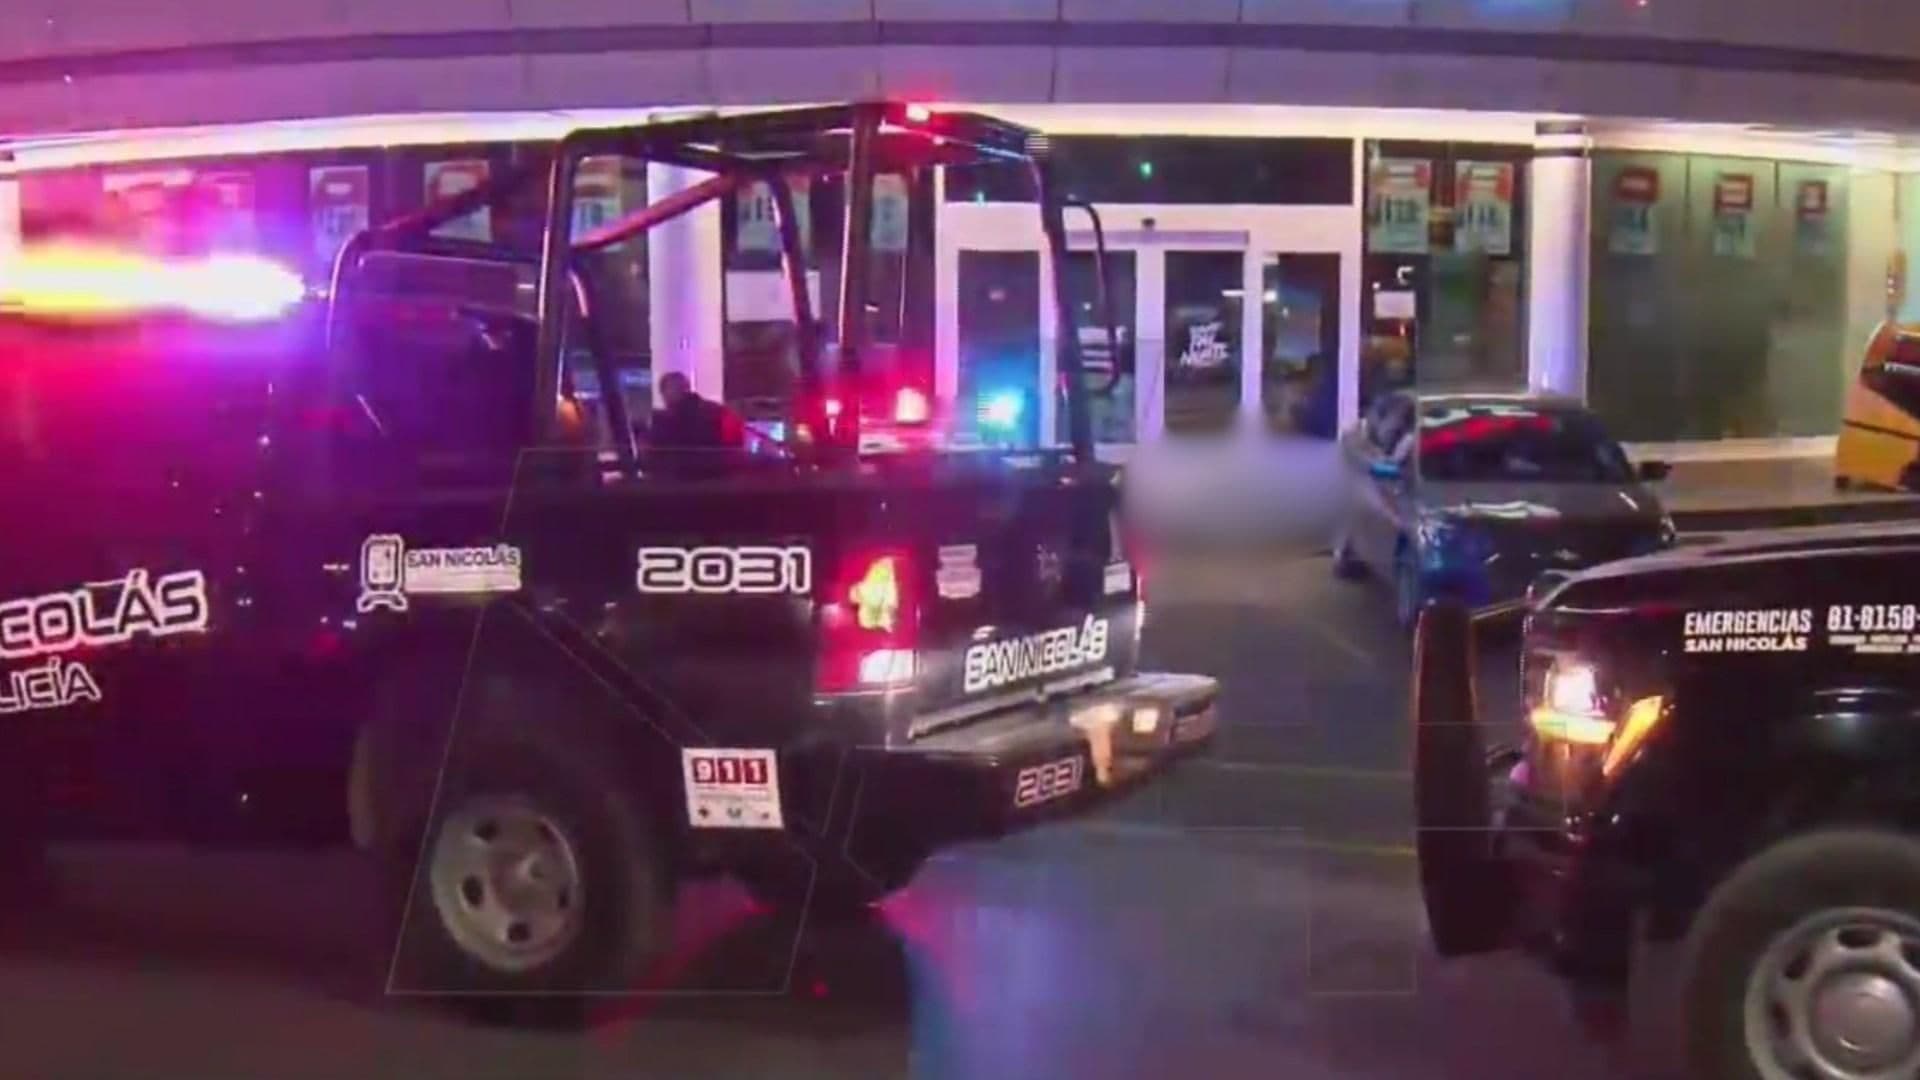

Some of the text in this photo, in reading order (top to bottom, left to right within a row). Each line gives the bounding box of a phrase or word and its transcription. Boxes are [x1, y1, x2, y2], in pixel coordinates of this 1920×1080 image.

[406, 546, 517, 567] SAN NICOLÁS
[638, 546, 812, 594] 2031
[1684, 609, 1813, 635] EMERGENCIAS
[1684, 636, 1722, 652] SAN
[1726, 632, 1808, 652] NICOLÁS
[965, 640, 1018, 692] SAN
[694, 758, 766, 783] 911
[1014, 755, 1083, 807] 2031
